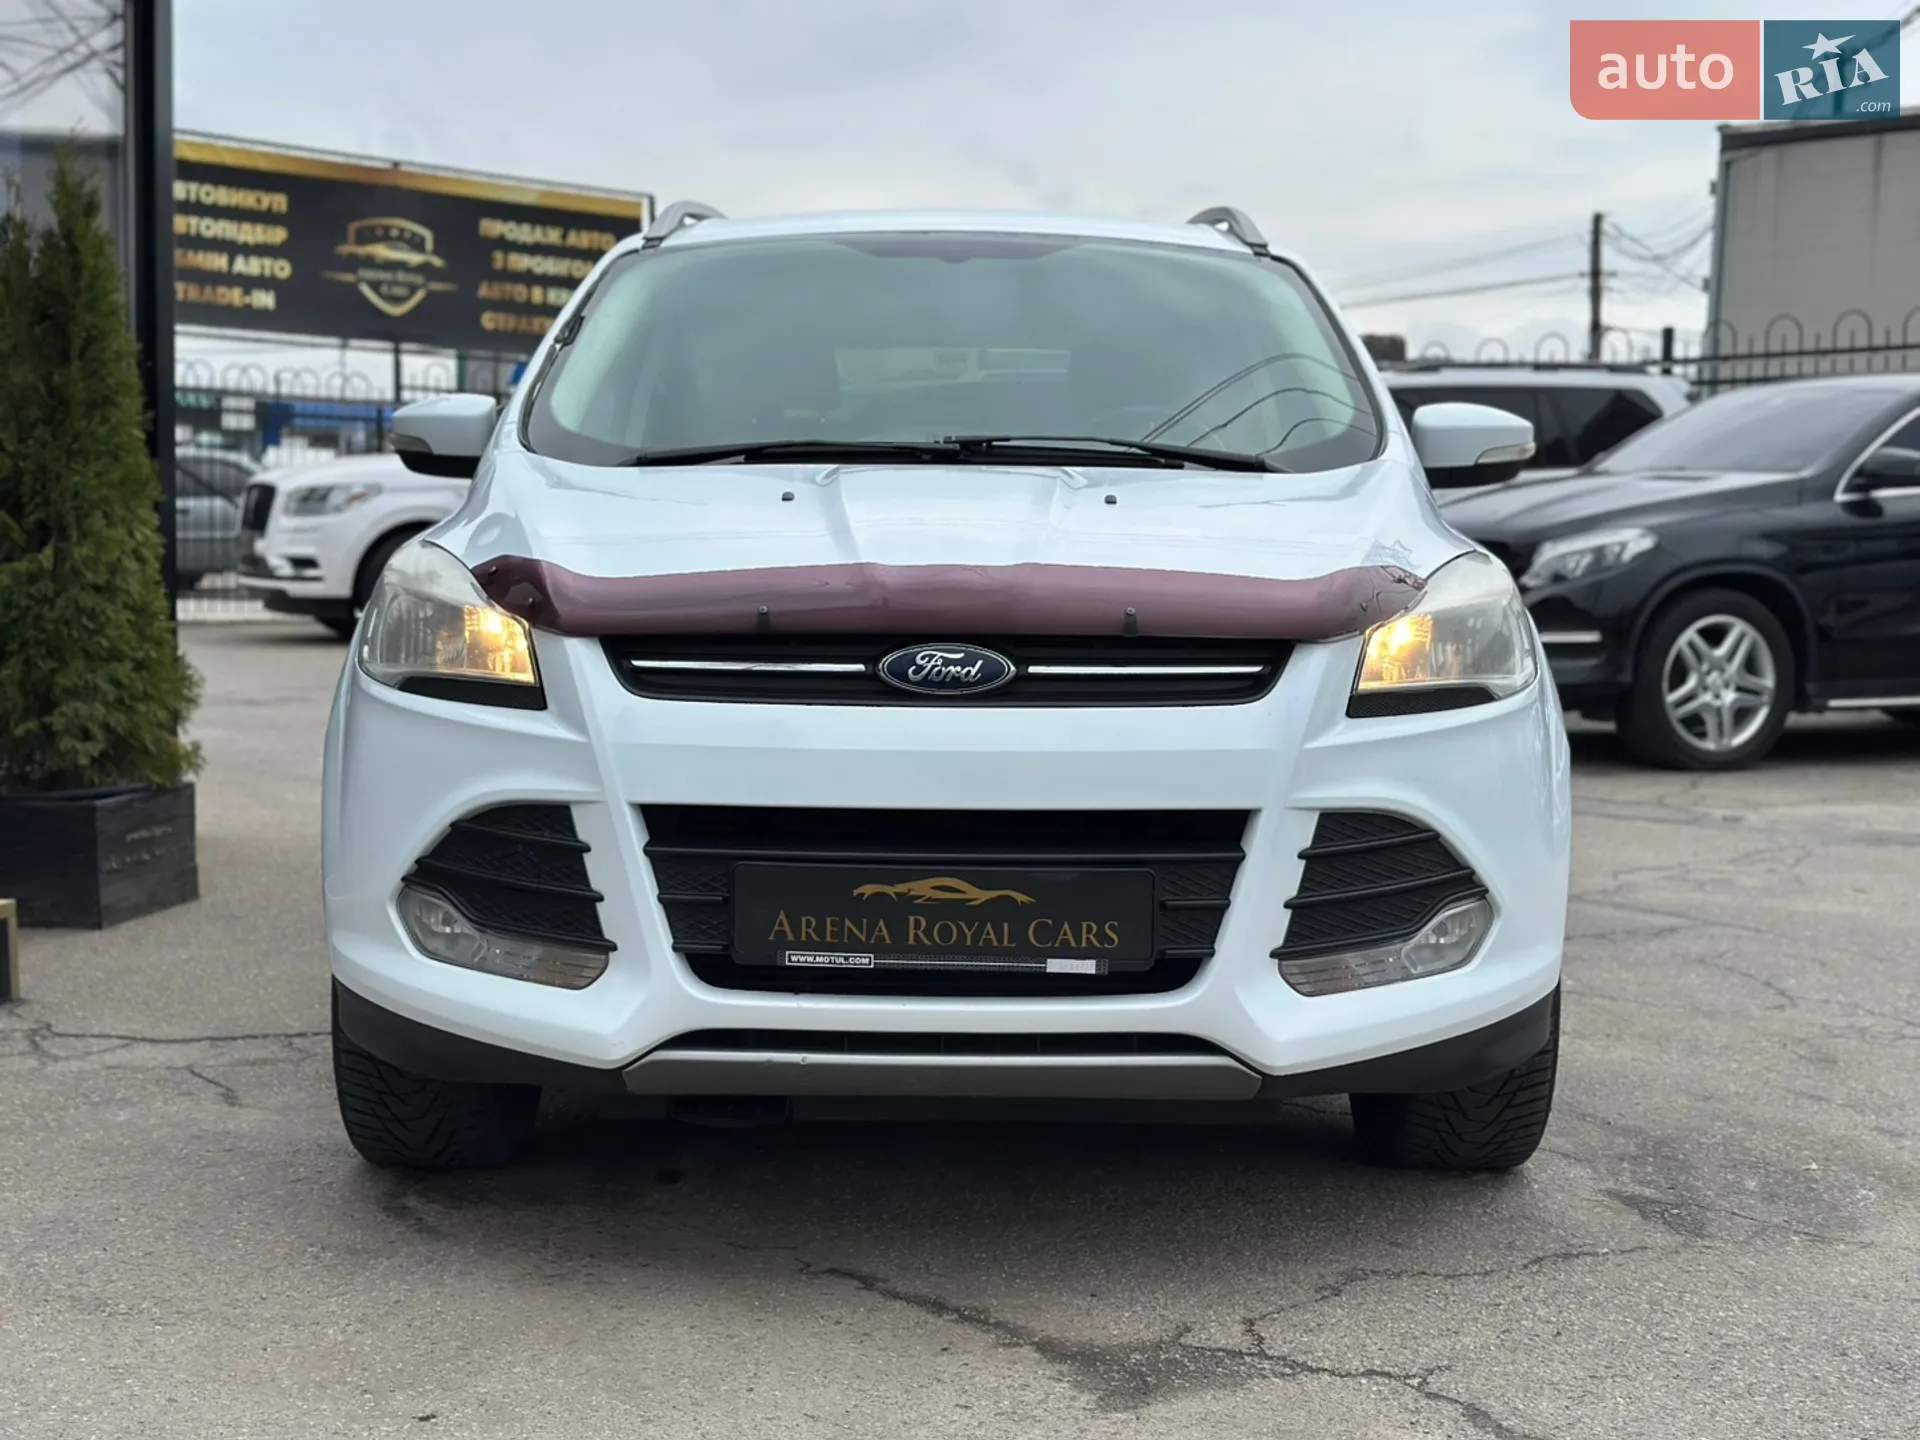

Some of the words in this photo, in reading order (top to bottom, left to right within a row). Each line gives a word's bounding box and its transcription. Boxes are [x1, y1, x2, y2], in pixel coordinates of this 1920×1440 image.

[173, 180, 288, 214] ВТОВИКУП
[173, 213, 289, 246] ВТОПІДБІР
[231, 253, 292, 279] АВТО
[174, 281, 276, 311] TRADE-IN
[908, 651, 984, 682] Ford
[768, 909, 892, 944] ARENA
[907, 915, 1016, 947] ROYAL
[1027, 918, 1119, 948] CARS
[790, 955, 870, 965] WWW.MOTUL.COM
